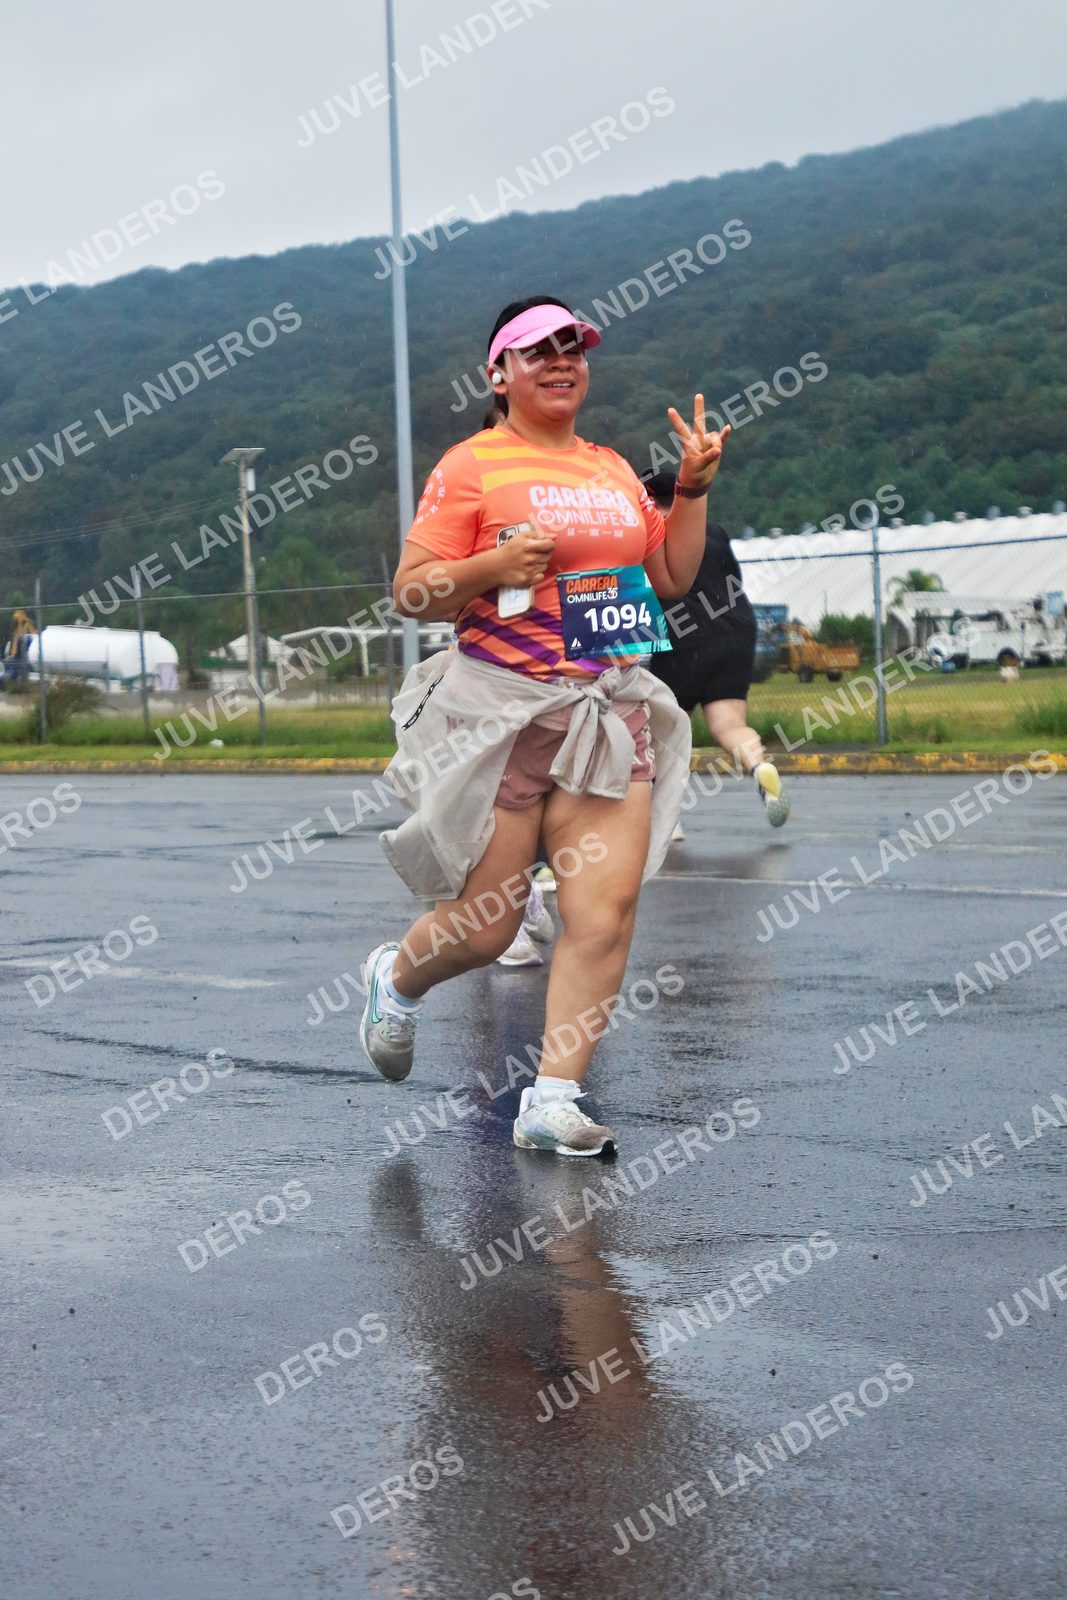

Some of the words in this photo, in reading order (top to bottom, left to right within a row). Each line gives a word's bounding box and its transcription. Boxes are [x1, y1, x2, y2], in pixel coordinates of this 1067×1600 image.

[529, 485, 634, 512] CARRERA
[565, 575, 618, 593] CARRERA
[584, 603, 651, 632] 1094
